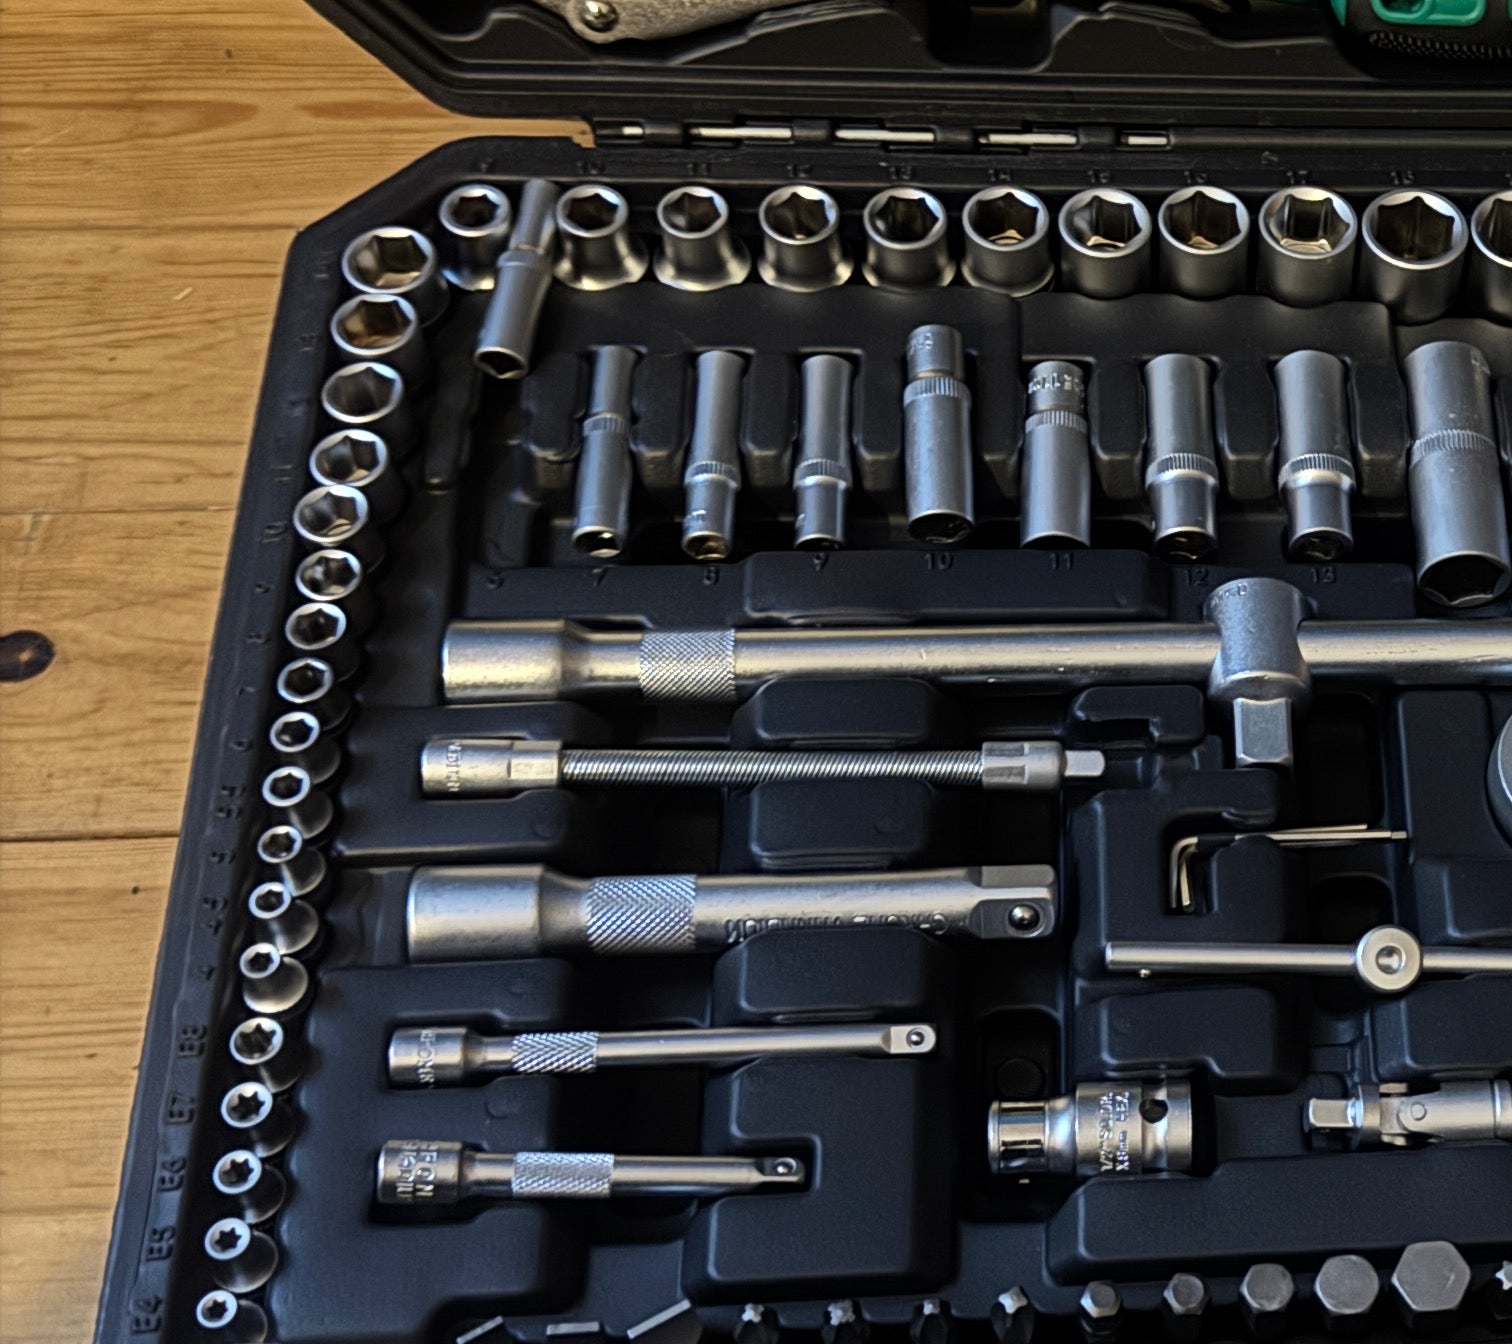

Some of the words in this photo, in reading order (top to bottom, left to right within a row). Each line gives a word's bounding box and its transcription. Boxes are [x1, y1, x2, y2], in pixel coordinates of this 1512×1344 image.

[924, 551, 956, 571] 10
[1049, 551, 1076, 571] 11
[1186, 567, 1211, 588] 12
[1309, 566, 1339, 586] 13
[178, 1023, 208, 1059] E8
[166, 1090, 196, 1125] E7
[157, 1155, 187, 1194] E6
[146, 1225, 177, 1262] E5
[130, 1294, 164, 1335] E4
